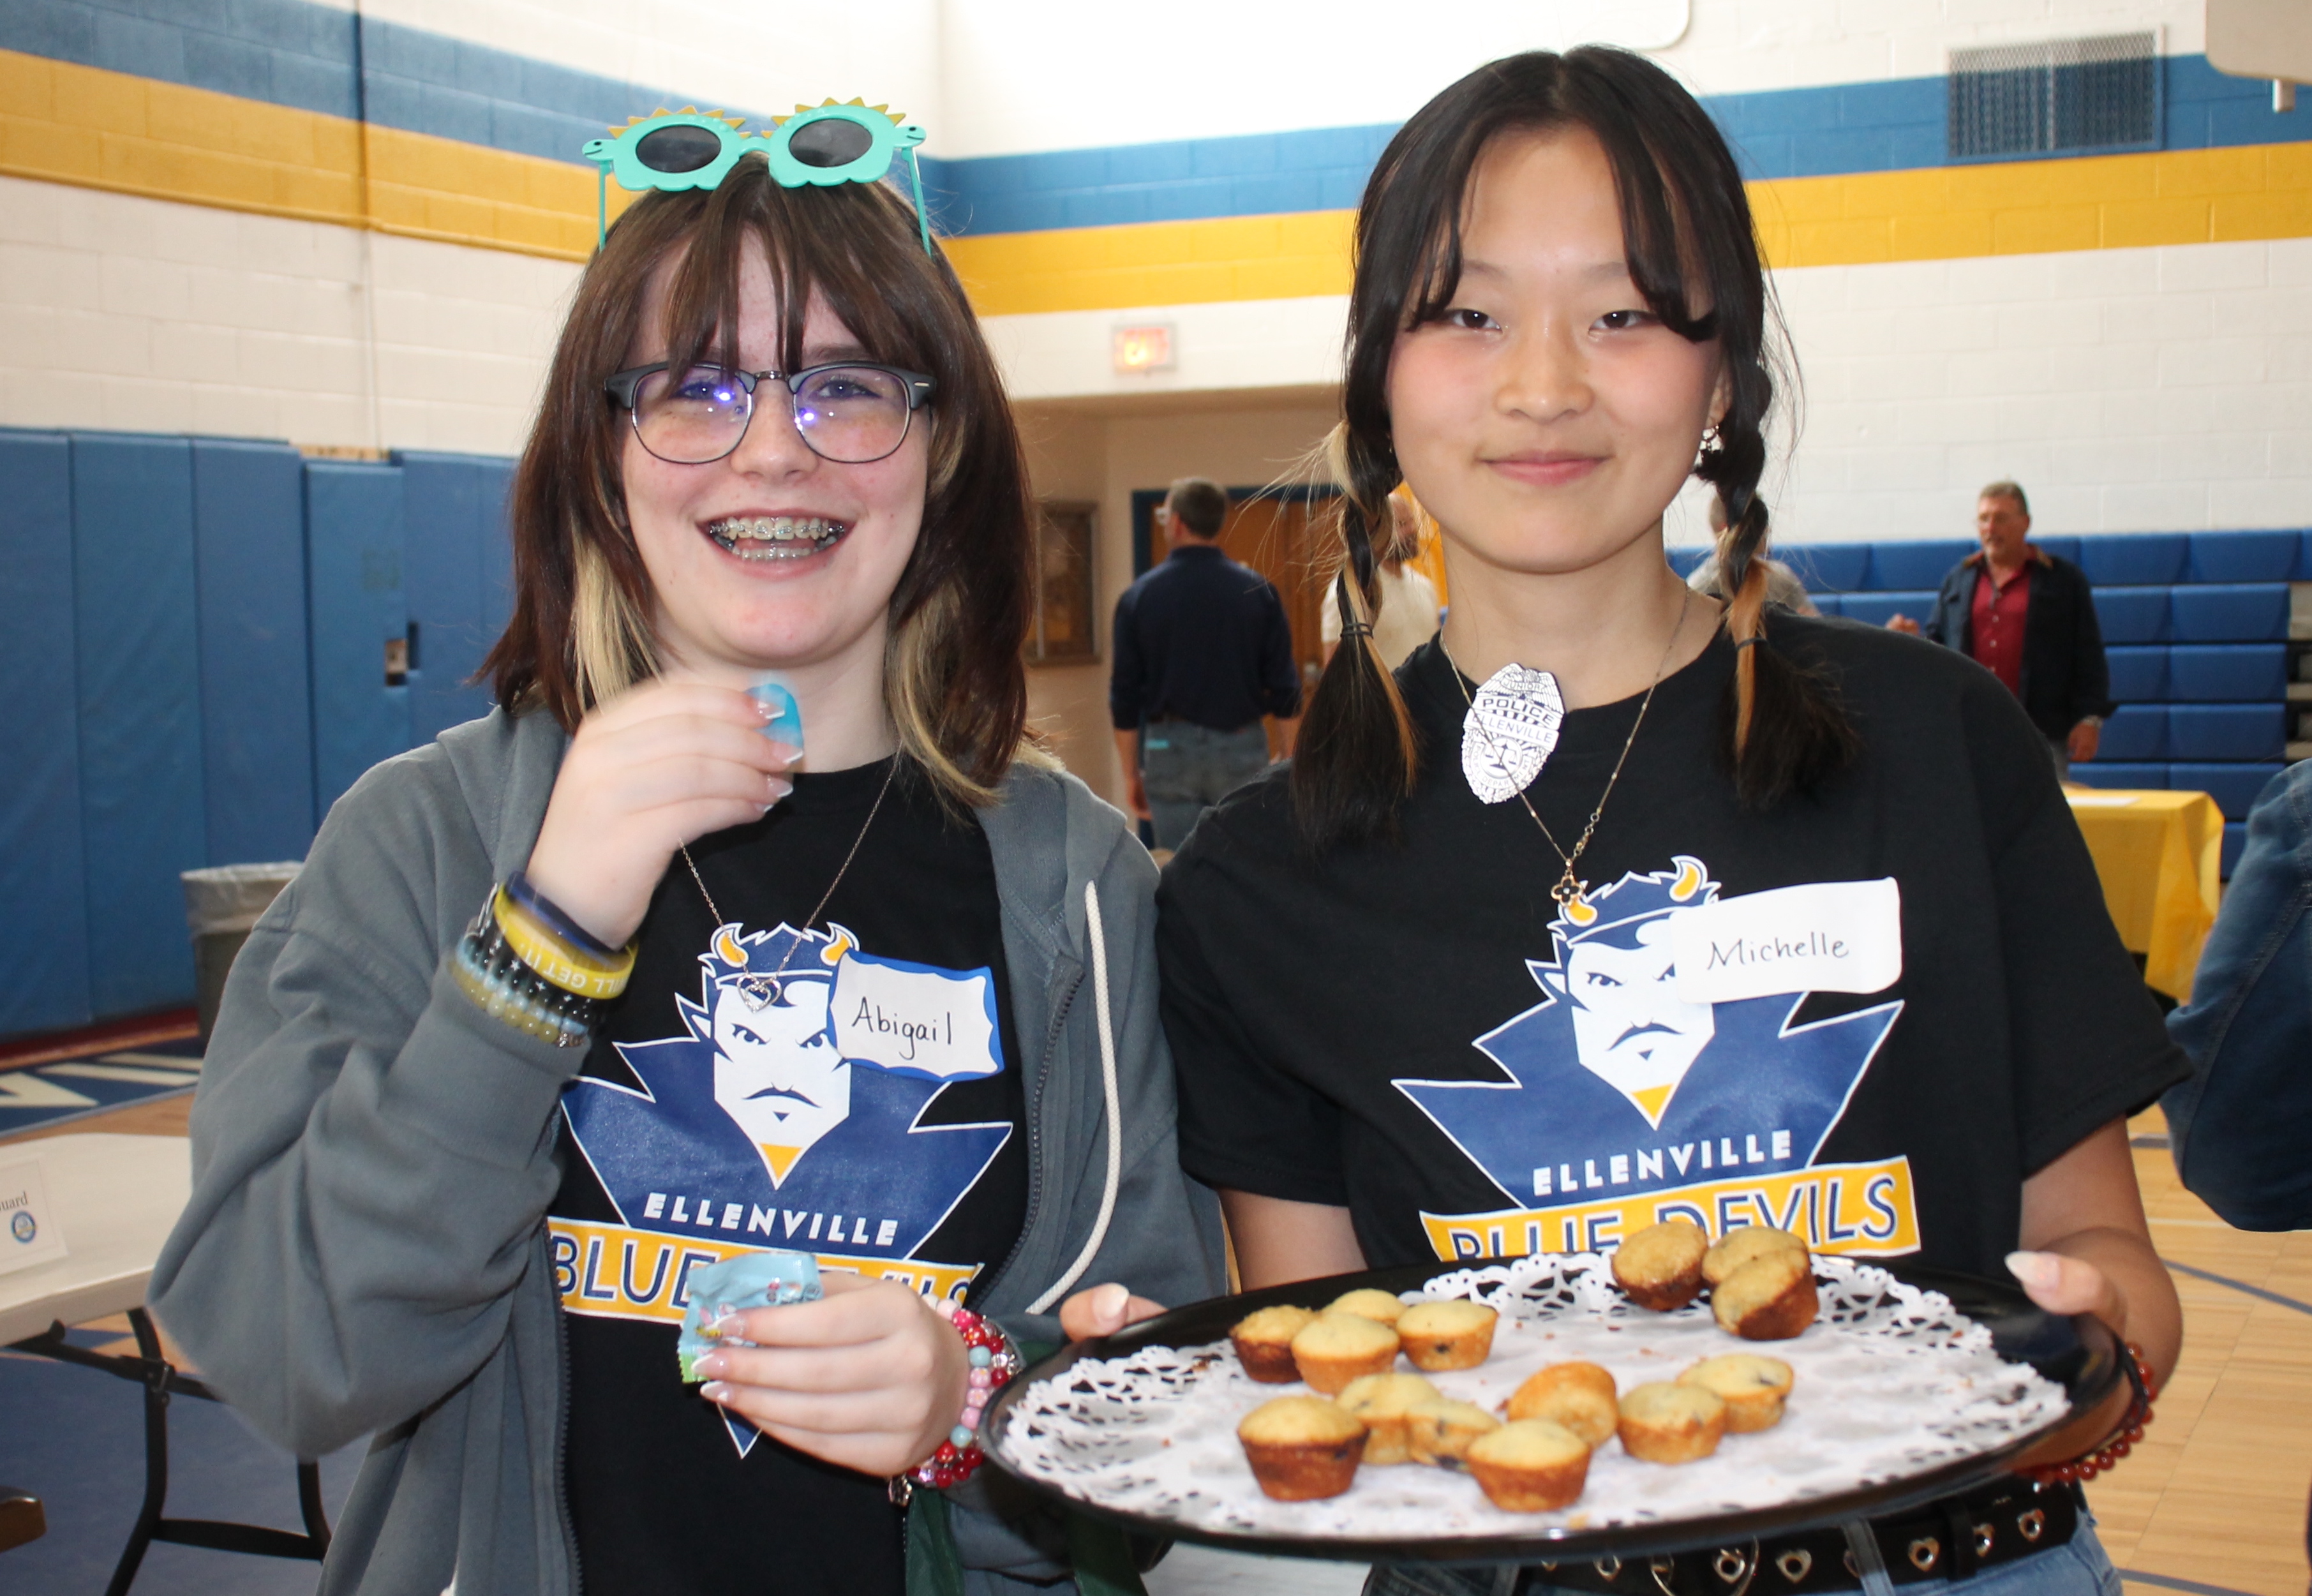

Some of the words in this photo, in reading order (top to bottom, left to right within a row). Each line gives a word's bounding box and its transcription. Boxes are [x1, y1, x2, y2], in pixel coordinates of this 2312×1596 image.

[1503, 680, 1541, 690] JUNIOR
[1482, 698, 1555, 726] POLICE
[1472, 713, 1554, 744] ELLENVILLE
[1707, 931, 1849, 971] Michelle
[543, 961, 587, 989] GET
[851, 996, 952, 1061] Abigail
[1533, 1129, 1793, 1197] ELLENVILLE
[0, 1190, 29, 1211] uard
[643, 1192, 899, 1247] ELLENVILLE
